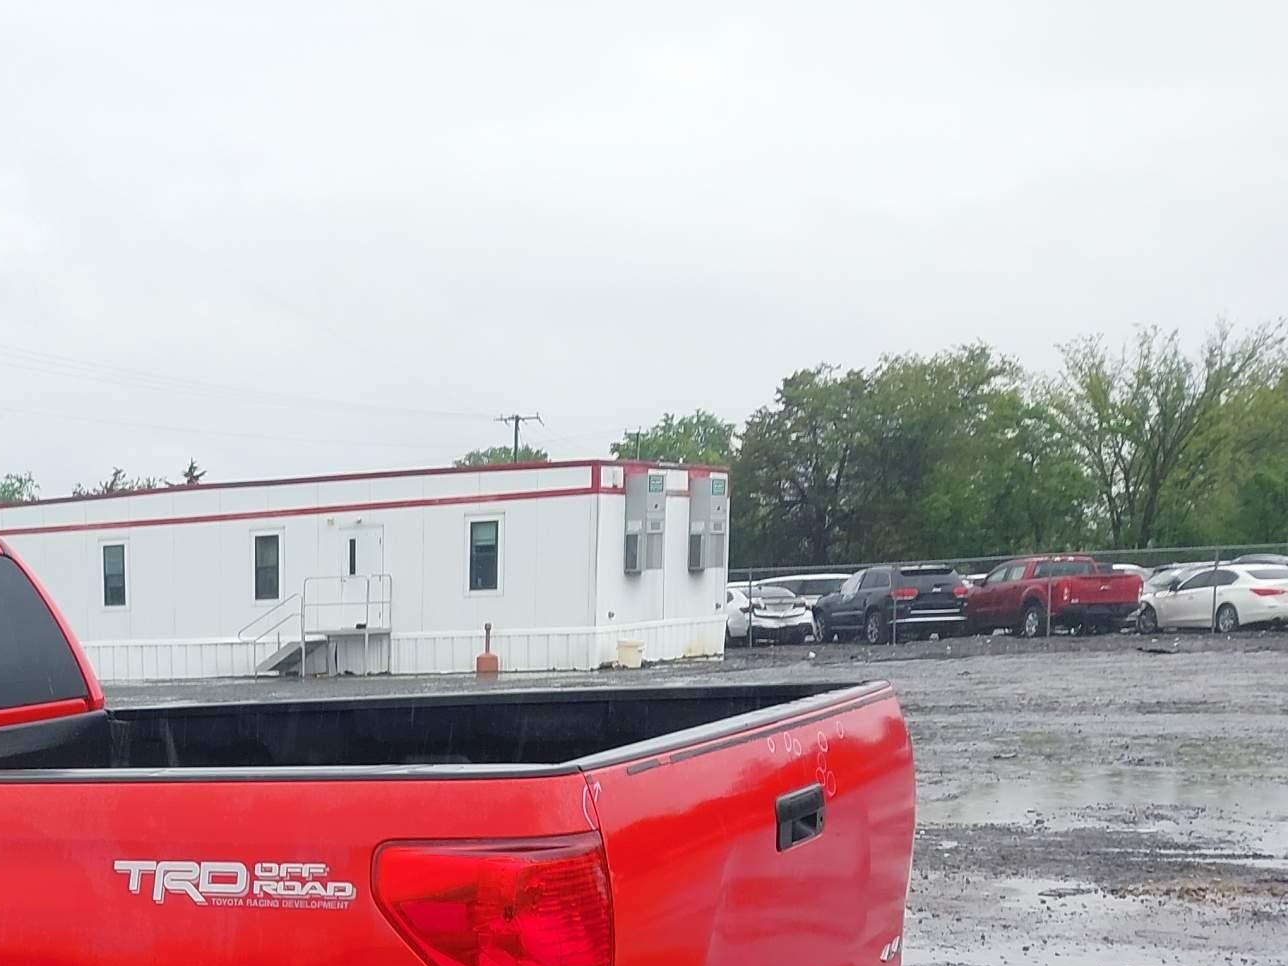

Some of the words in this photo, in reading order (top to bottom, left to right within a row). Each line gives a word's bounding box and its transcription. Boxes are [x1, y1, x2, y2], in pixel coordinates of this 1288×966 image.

[254, 862, 329, 878] OFF
[114, 860, 249, 905] TRD
[253, 880, 356, 899] ROAD
[211, 898, 244, 907] TOYOTA
[246, 899, 280, 908] RACING
[281, 900, 349, 910] DEVELOPMENT
